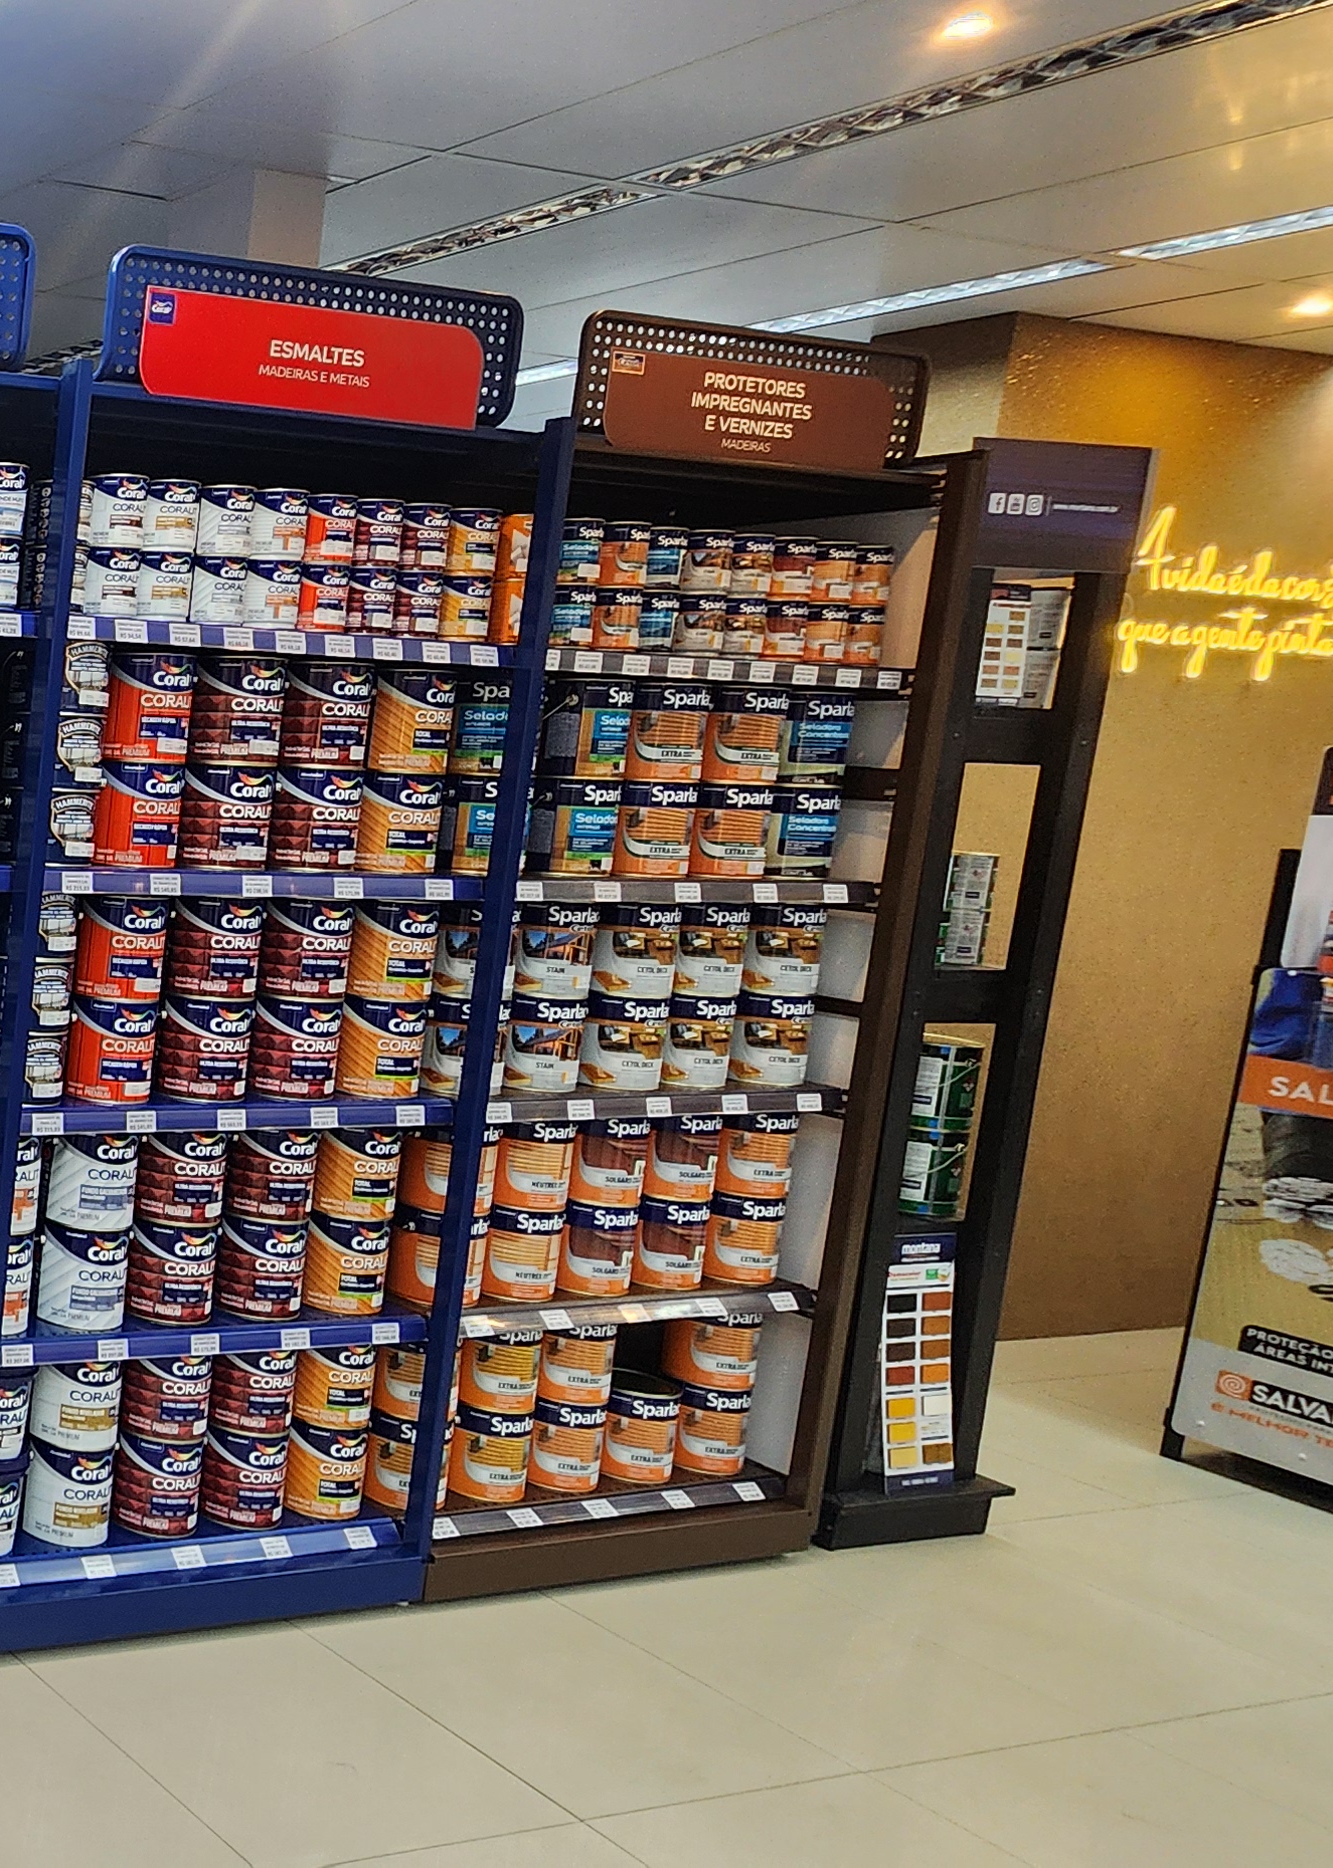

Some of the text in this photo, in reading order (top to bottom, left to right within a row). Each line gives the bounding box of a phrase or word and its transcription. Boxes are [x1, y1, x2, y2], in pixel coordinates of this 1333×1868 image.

[270, 339, 365, 368] ESMALTES
[258, 364, 370, 389] MADEIRAS E METAIS
[704, 371, 807, 399] PROTETORES
[691, 391, 813, 421] IMPREGNANTES
[704, 414, 794, 440] E VERNIZES
[720, 437, 772, 454] MADEIRAS
[1136, 504, 1177, 591] A
[1161, 544, 1227, 595] vida
[1117, 617, 1171, 674] que
[1184, 606, 1265, 678] gente
[1251, 612, 1333, 682] pinta
[153, 670, 190, 687] Coral
[242, 675, 281, 691] Coral
[88, 1246, 125, 1263] Coral
[1246, 1328, 1333, 1360] PROTEÇÃO
[1254, 1343, 1307, 1366] ÁREAS
